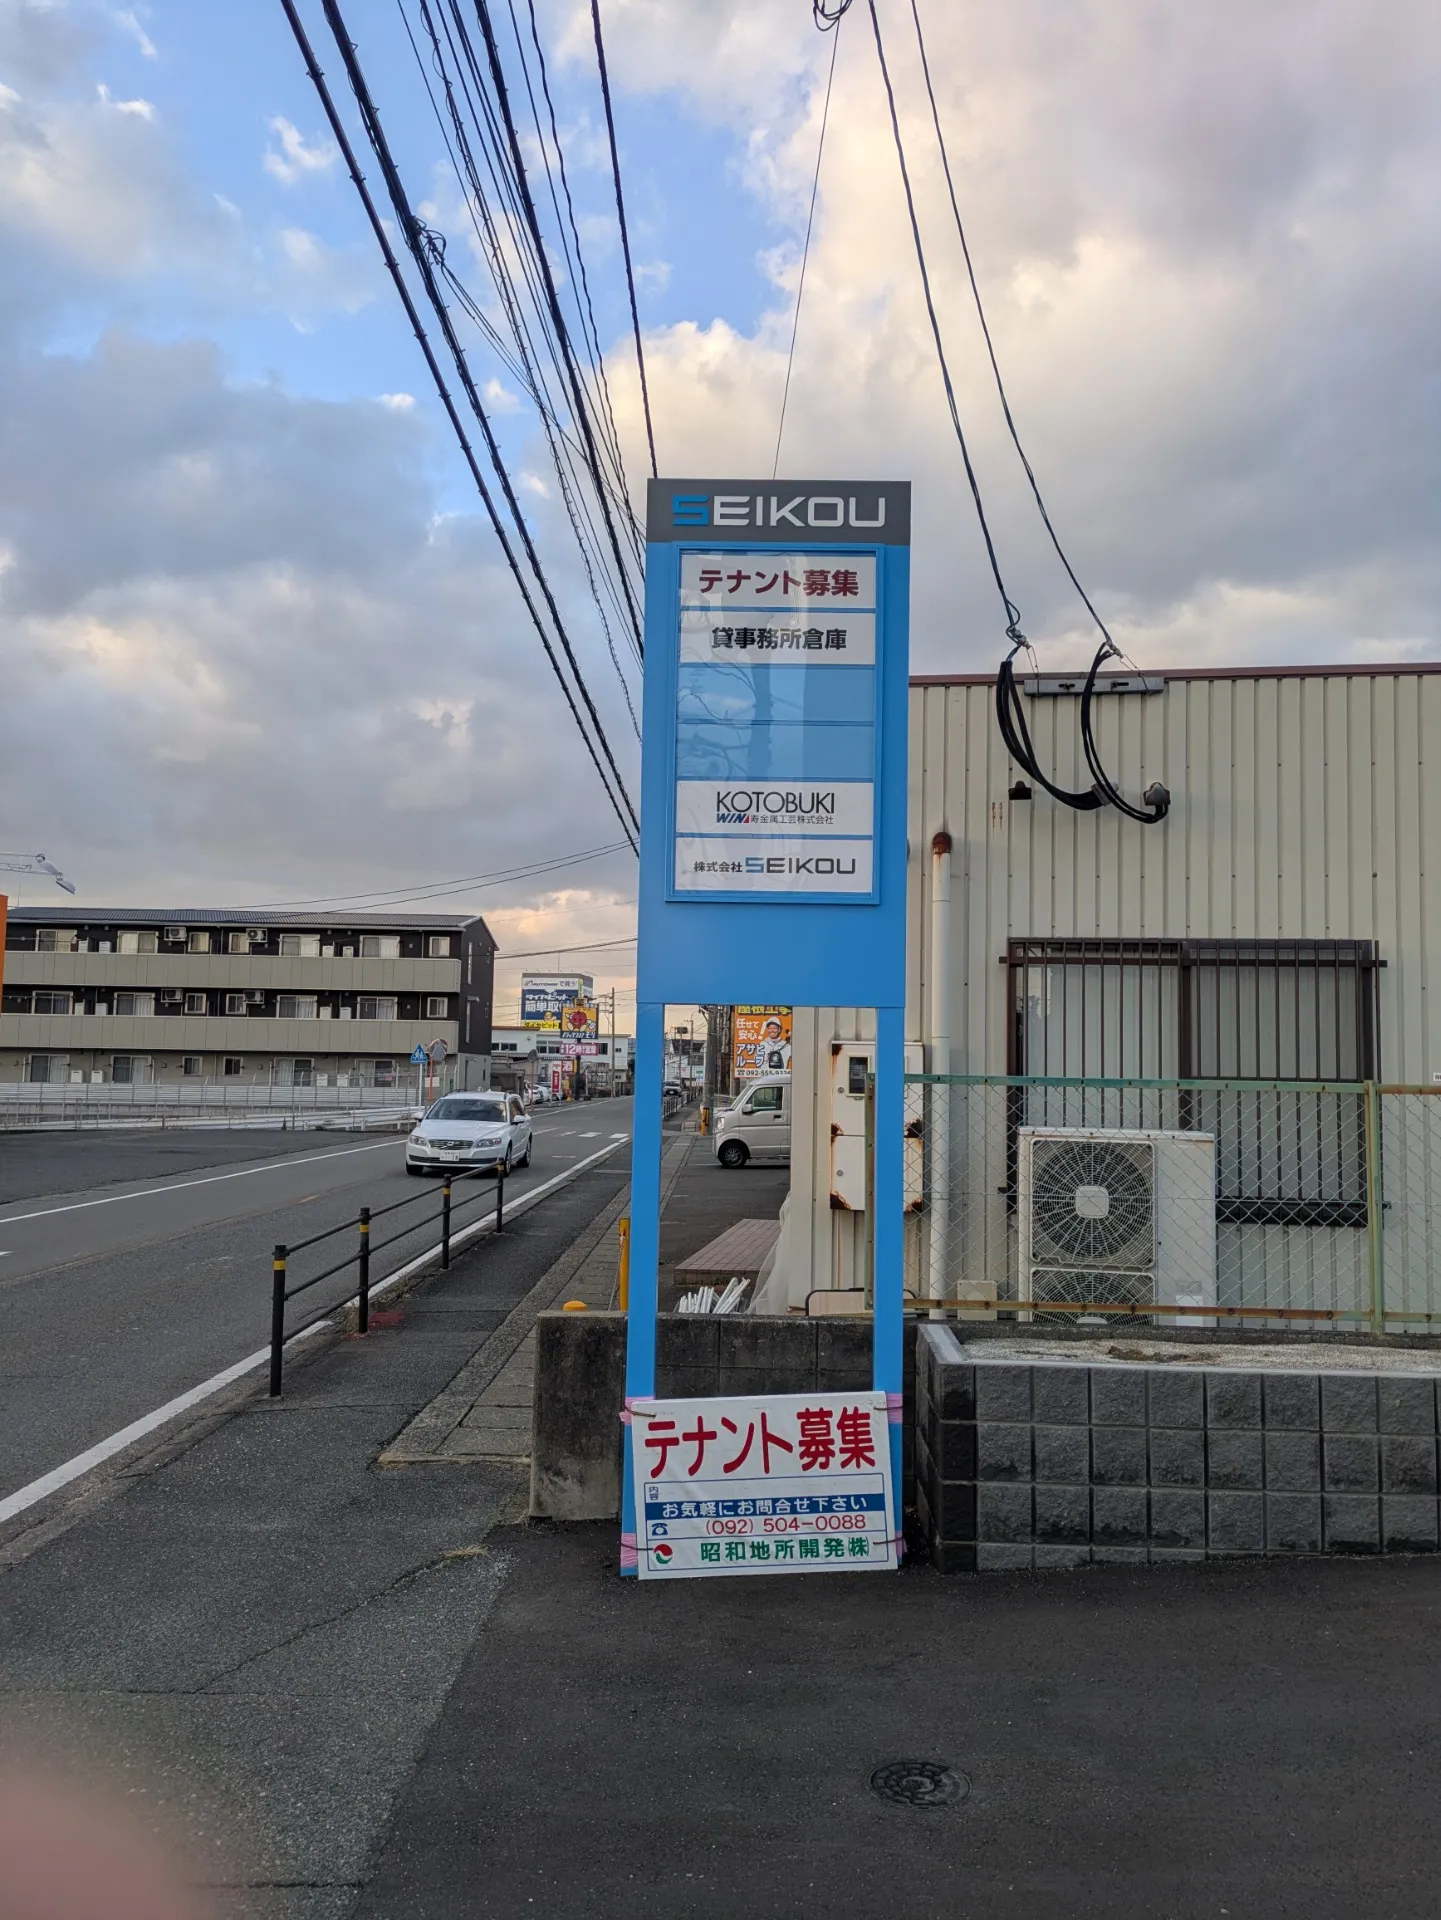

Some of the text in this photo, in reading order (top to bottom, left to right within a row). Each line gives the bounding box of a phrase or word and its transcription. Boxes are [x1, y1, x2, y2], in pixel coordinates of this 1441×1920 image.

[672, 494, 886, 527] SEIKOU
[699, 569, 859, 597] テナント募集
[711, 627, 847, 651] 貸事務所倉庫
[716, 791, 835, 814] KOTOBUKI
[750, 814, 834, 825] 寿金属工芸株式会社
[736, 1043, 766, 1055] アサヒ
[645, 1406, 876, 1479] テナント募集
[662, 1496, 868, 1518] お気軽にお問合せ下さい
[763, 1514, 867, 1534] 504-0088
